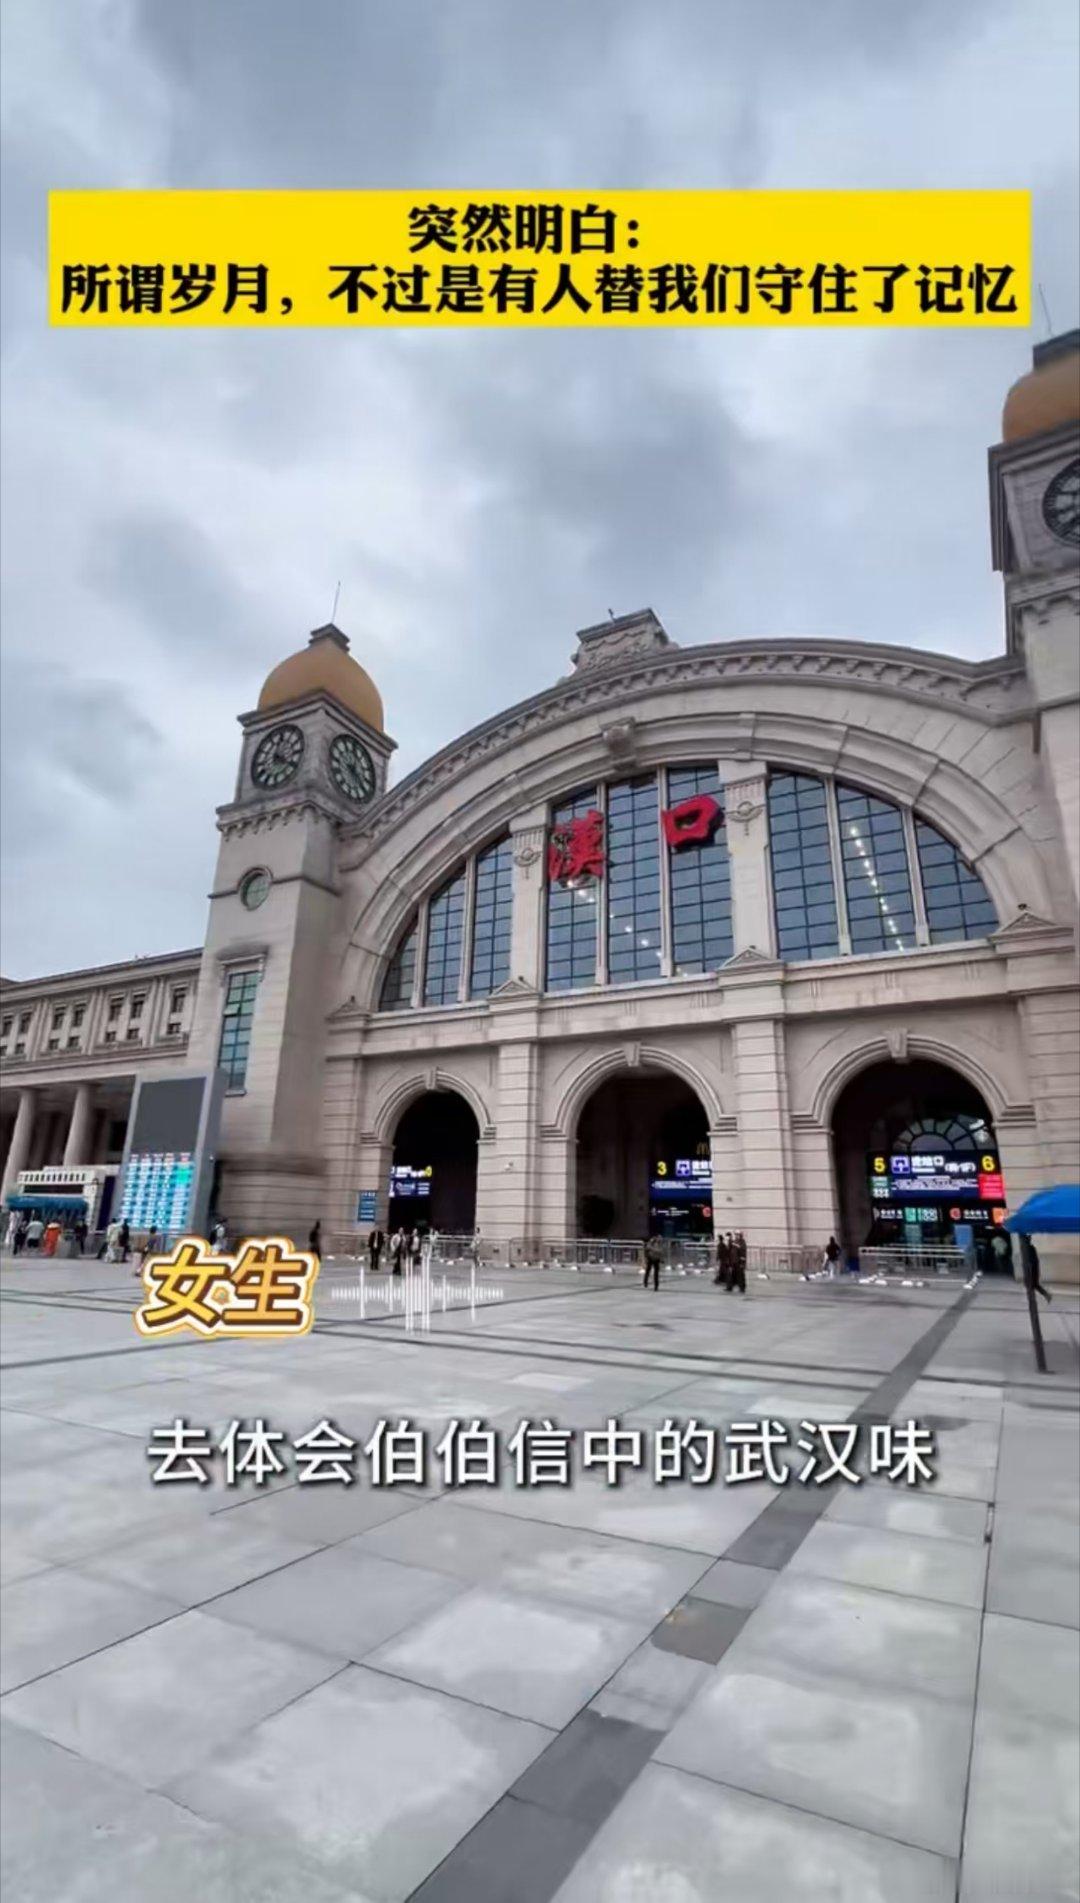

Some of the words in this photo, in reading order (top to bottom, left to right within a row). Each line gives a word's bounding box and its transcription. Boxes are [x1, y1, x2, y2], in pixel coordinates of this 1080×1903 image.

[657, 1161, 668, 1176] 3
[873, 1156, 887, 1173] 5
[981, 1155, 996, 1172] 6
